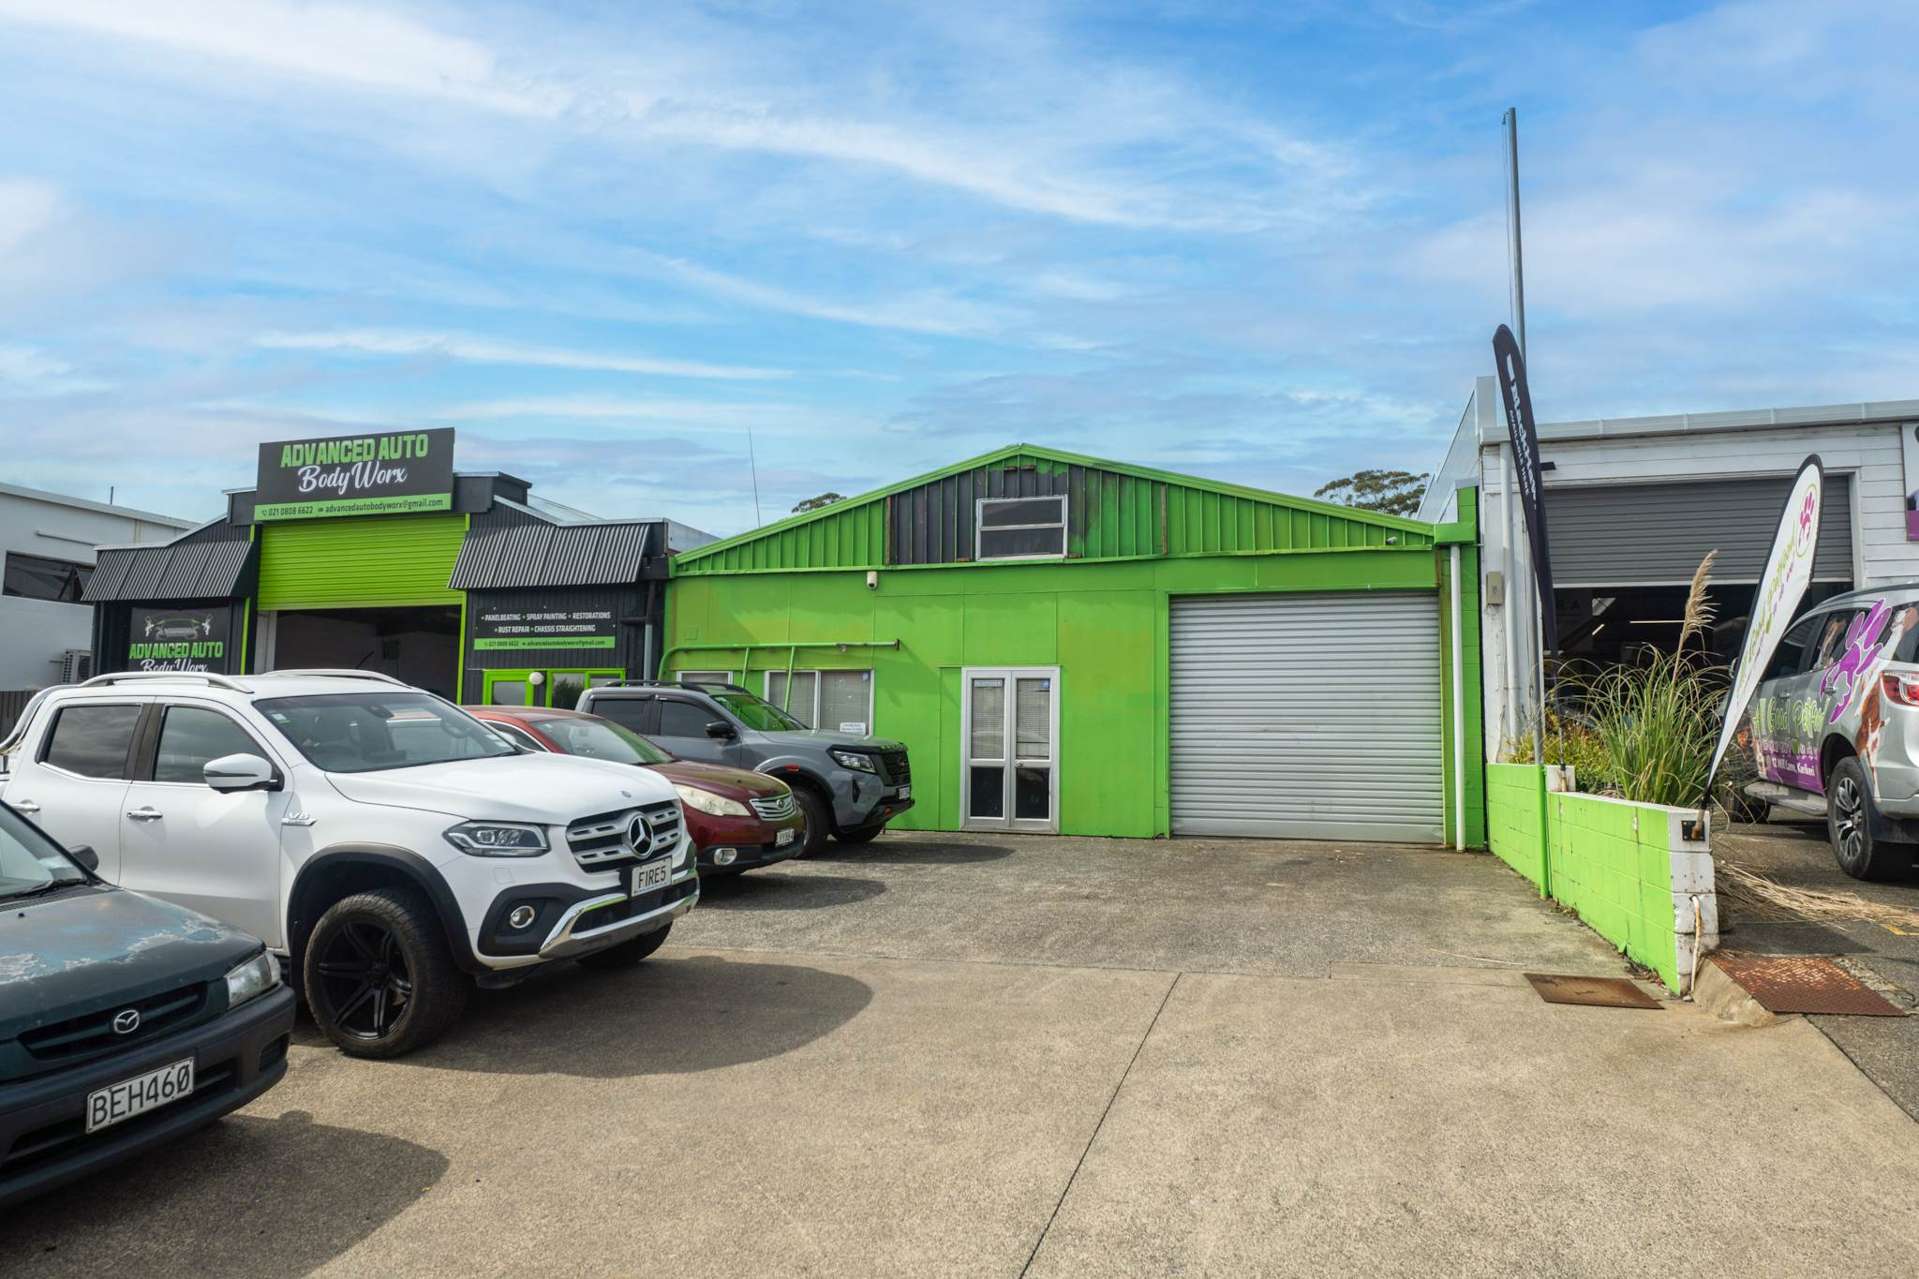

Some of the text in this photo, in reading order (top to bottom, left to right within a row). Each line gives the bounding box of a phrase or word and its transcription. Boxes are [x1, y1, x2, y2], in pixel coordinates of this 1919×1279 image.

[280, 434, 429, 468] ADVANCED AUTO
[297, 460, 408, 495] Body Worx
[543, 612, 567, 620] PAINTING
[572, 611, 611, 619] RESTORATIONS
[498, 624, 596, 633] RUST REPAIR CHASSIS STRAIGHTENING
[129, 641, 224, 659] ADVANCED AUTO
[639, 865, 666, 889] FIRE5
[92, 1064, 190, 1126] BEH460
